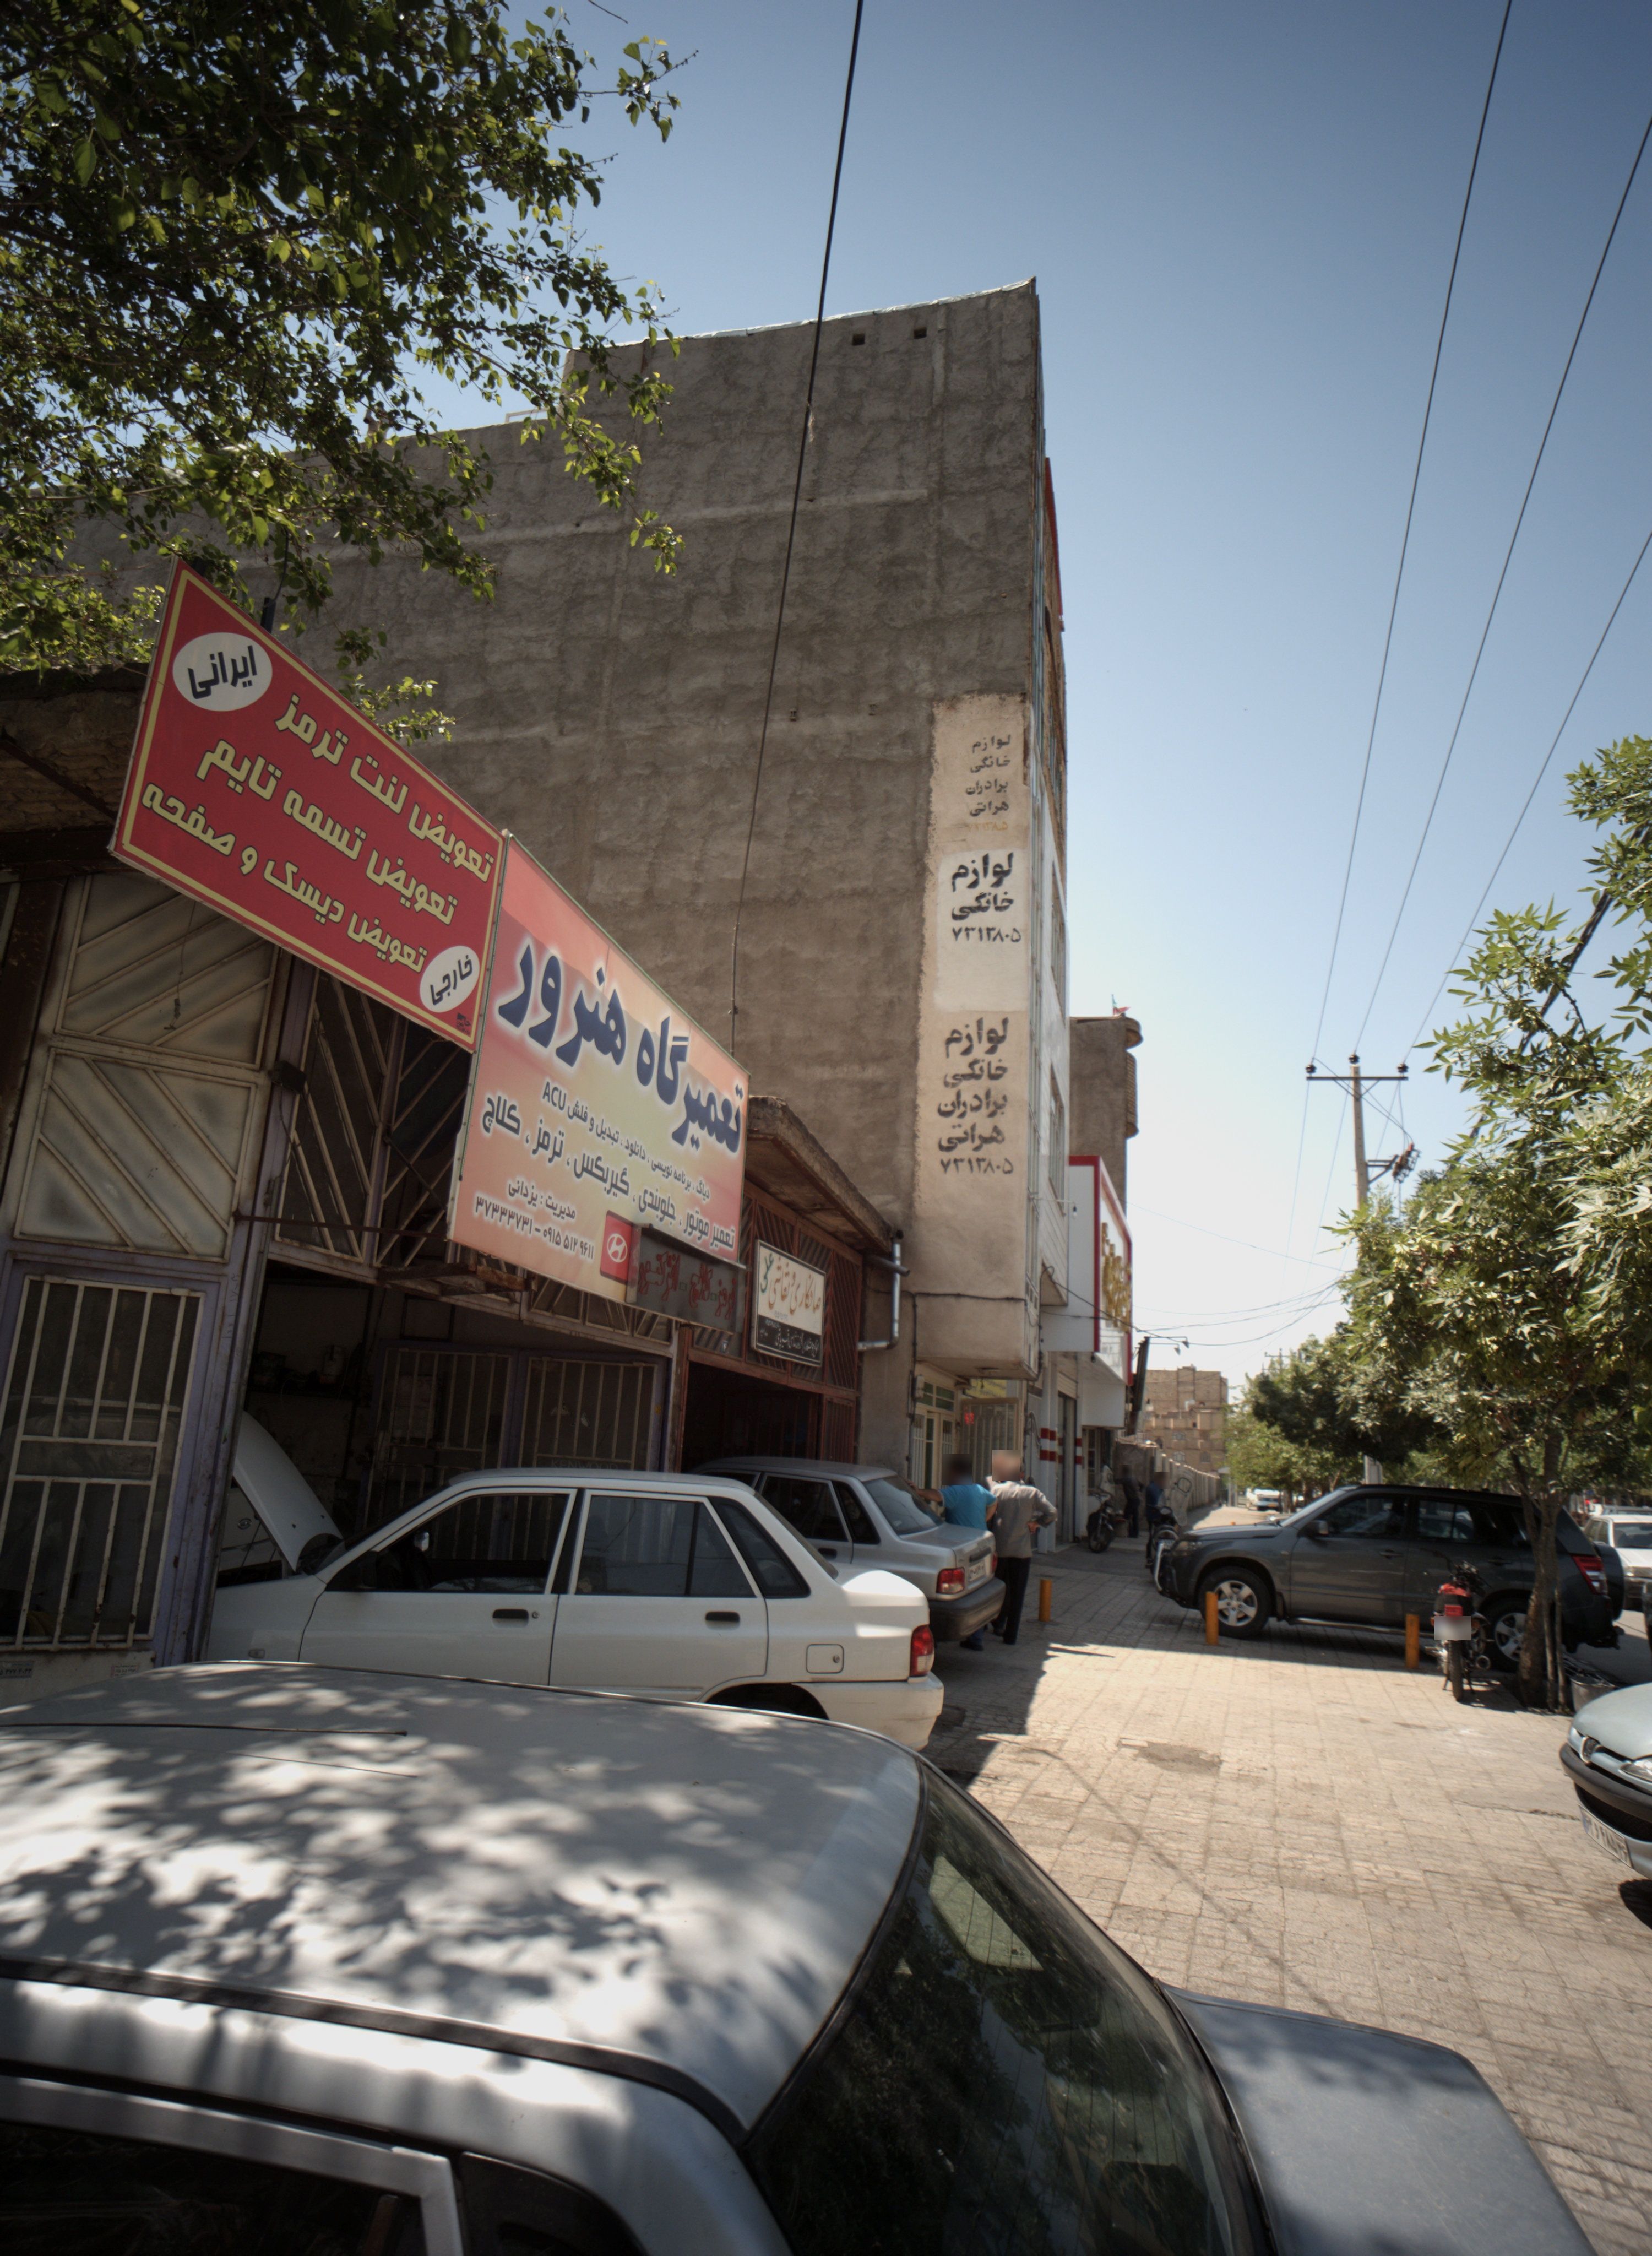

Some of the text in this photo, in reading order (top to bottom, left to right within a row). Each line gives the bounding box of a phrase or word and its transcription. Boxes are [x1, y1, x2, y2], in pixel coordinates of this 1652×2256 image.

[187, 644, 258, 700] ایرانی
[972, 734, 1011, 753] لوازم
[970, 756, 1011, 773] خانگی
[275, 693, 495, 883] تعویض لنت ترمز
[965, 778, 1009, 796] برادران
[970, 800, 1009, 817] هراتی
[195, 738, 459, 925] تعویض تسمه تایم
[141, 782, 429, 974] تعویض دیسک و صفحه
[952, 852, 1014, 892] لوازم
[951, 892, 1014, 921] خانگی
[429, 955, 474, 1006] خارجی
[945, 1017, 1009, 1059] لوازم
[943, 1059, 1008, 1088] خانگی
[542, 1081, 567, 1111] ACU
[567, 1100, 588, 1122] فلش
[937, 1088, 1008, 1119] برادران
[482, 1096, 520, 1136] کلاچ
[589, 1117, 594, 1132] و
[532, 1119, 564, 1163] ترمز
[596, 1119, 619, 1146] تبدیل
[938, 1122, 1006, 1152] هراتی
[624, 1138, 646, 1160] دانلود
[574, 1153, 629, 1197] گیربکس
[651, 1159, 672, 1179] نویسی
[508, 1180, 537, 1207] یزدانی
[696, 1180, 710, 1201] دیاگ
[476, 1196, 532, 1234] ۳۷۳۳۳۷۳۱
[543, 1227, 561, 1246] ۰۹۱۵
[545, 1195, 575, 1220] مدیریت
[639, 1188, 676, 1225] جلوبندی
[683, 1210, 709, 1241] موتور
[710, 1225, 735, 1248] تعمیر
